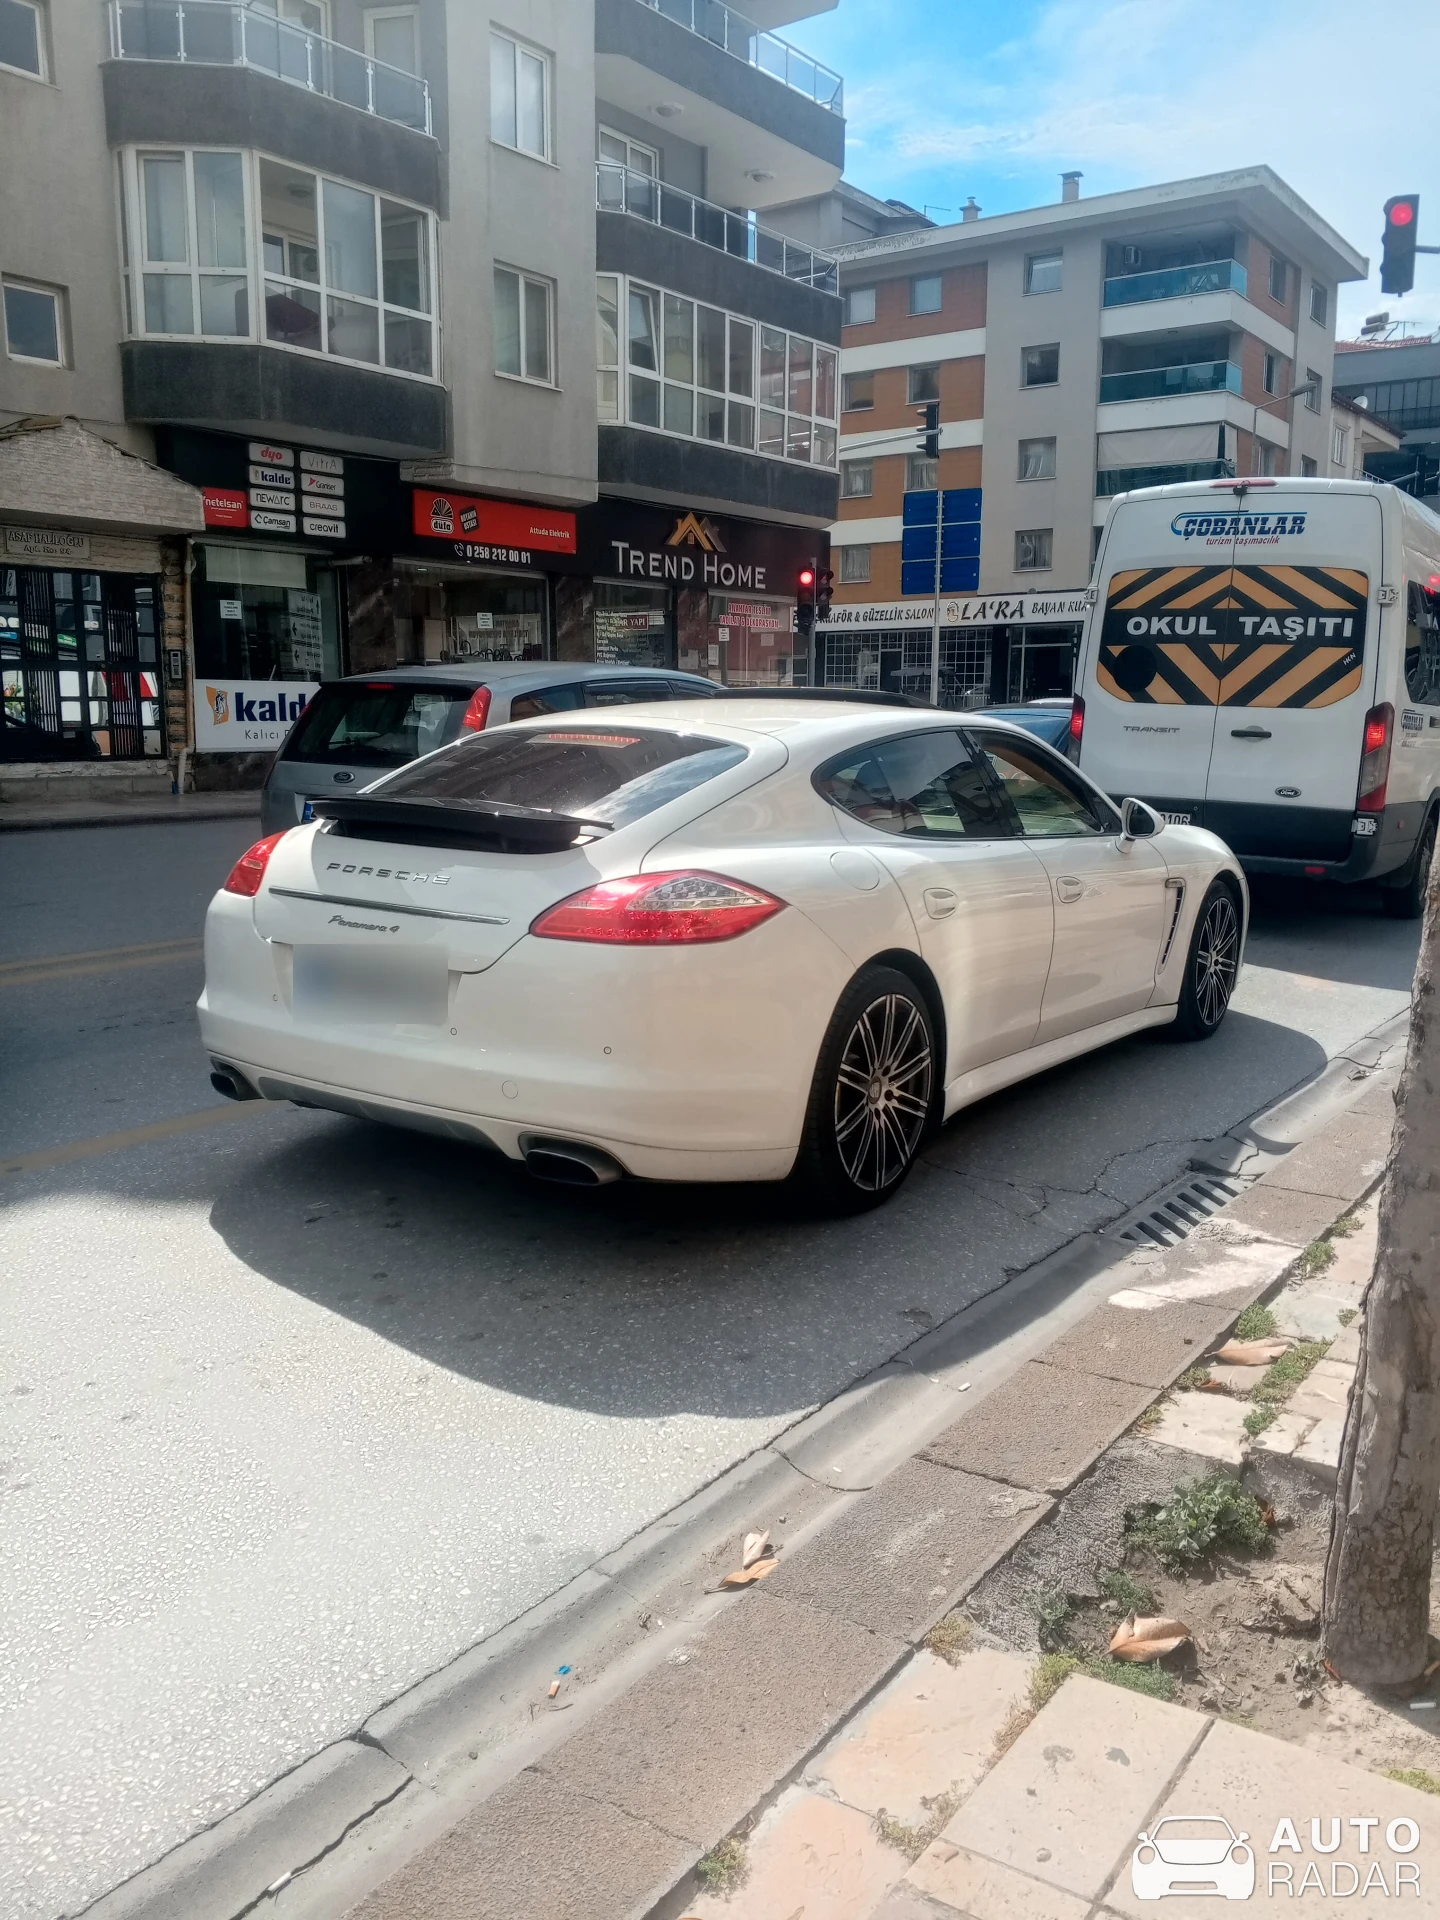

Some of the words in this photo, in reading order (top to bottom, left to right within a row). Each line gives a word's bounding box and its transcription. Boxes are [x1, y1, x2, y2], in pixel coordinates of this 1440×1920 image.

[261, 447, 283, 462] dyo
[308, 457, 337, 469] VitrA
[261, 471, 291, 485] kalde
[205, 498, 242, 509] netelsan
[309, 502, 338, 511] BRAAS
[263, 516, 291, 526] Çamsan
[309, 523, 338, 534] creavit
[530, 527, 549, 536] Attuda
[549, 529, 570, 538] Elektrik
[1183, 516, 1306, 541] ÇOBANLAR
[1206, 537, 1232, 546] turizm
[1235, 536, 1280, 546] taşımacılık
[467, 545, 472, 557] 0
[474, 546, 489, 559] 258
[492, 547, 507, 561] 212
[509, 550, 519, 563] 00
[522, 551, 531, 564] 01
[611, 540, 695, 580] TREND
[704, 554, 766, 589] HOME
[863, 607, 904, 622] GÜZELLİK
[1032, 601, 1066, 616] BAYAN
[630, 618, 645, 626] YAPI
[1126, 616, 1217, 636] OKUL
[1238, 616, 1354, 641] TAŞITI
[245, 729, 279, 739] Kalıcı
[327, 862, 452, 885] PORSCHE
[328, 915, 387, 933] Panamera
[389, 925, 400, 933] 4
